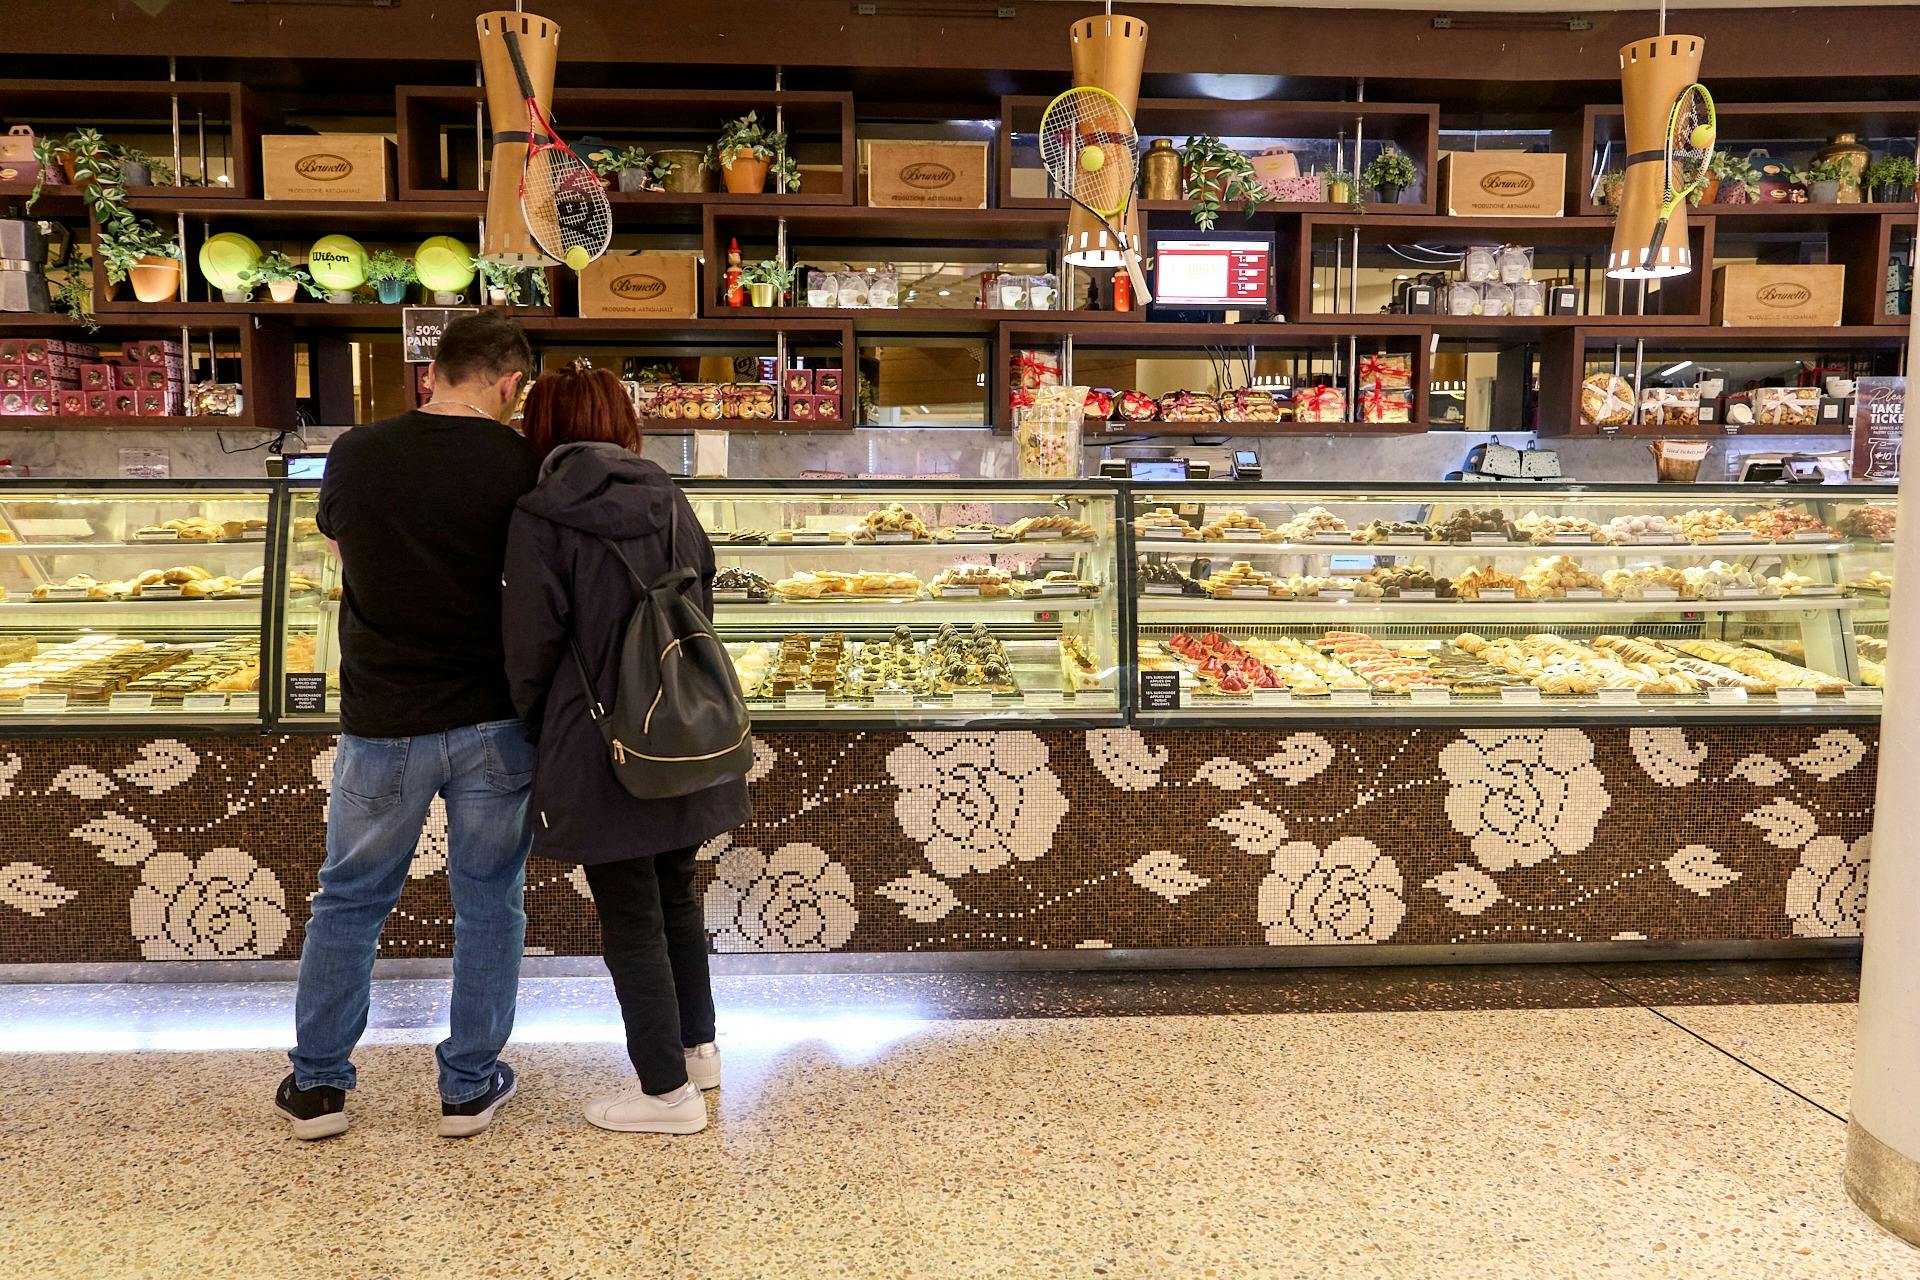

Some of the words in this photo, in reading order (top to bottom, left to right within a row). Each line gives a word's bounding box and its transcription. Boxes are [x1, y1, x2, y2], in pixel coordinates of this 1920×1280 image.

[300, 157, 347, 173] Brunetti
[903, 166, 950, 181] Brunetti
[1484, 175, 1530, 188] Brunetti
[313, 252, 349, 262] Wilson
[613, 277, 661, 292] Brunetti
[1760, 287, 1807, 300] Brunetti
[415, 325, 441, 335] 50%
[1871, 404, 1900, 413] TAKE
